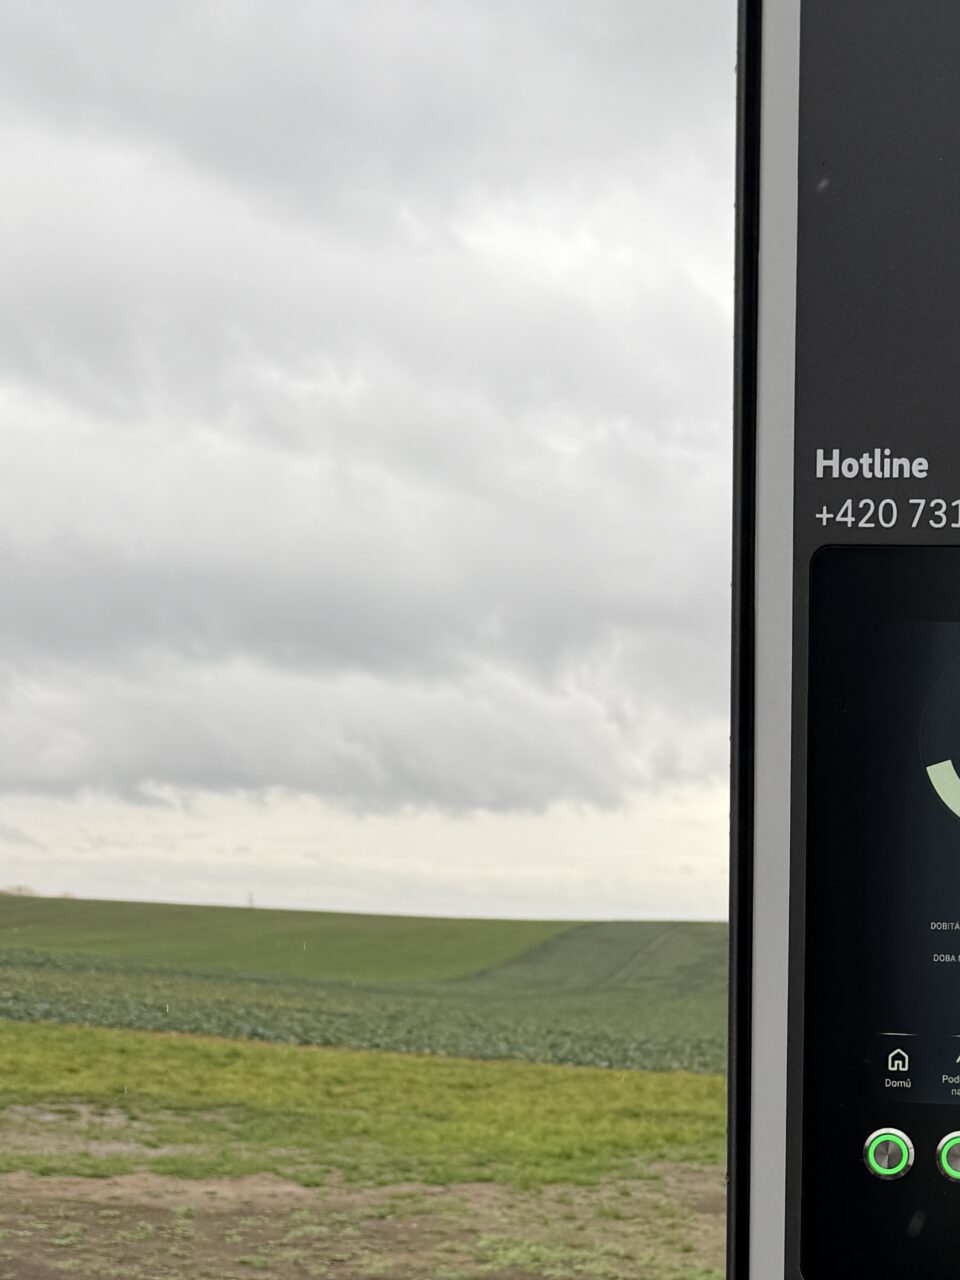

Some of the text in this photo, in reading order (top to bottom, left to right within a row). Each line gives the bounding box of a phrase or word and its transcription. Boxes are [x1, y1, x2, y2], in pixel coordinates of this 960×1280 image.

[815, 448, 929, 479] Hotline
[815, 499, 897, 529] +420
[930, 921, 960, 931] DOBITÁ
[933, 954, 956, 963] DOBA
[884, 1078, 912, 1088] Domů
